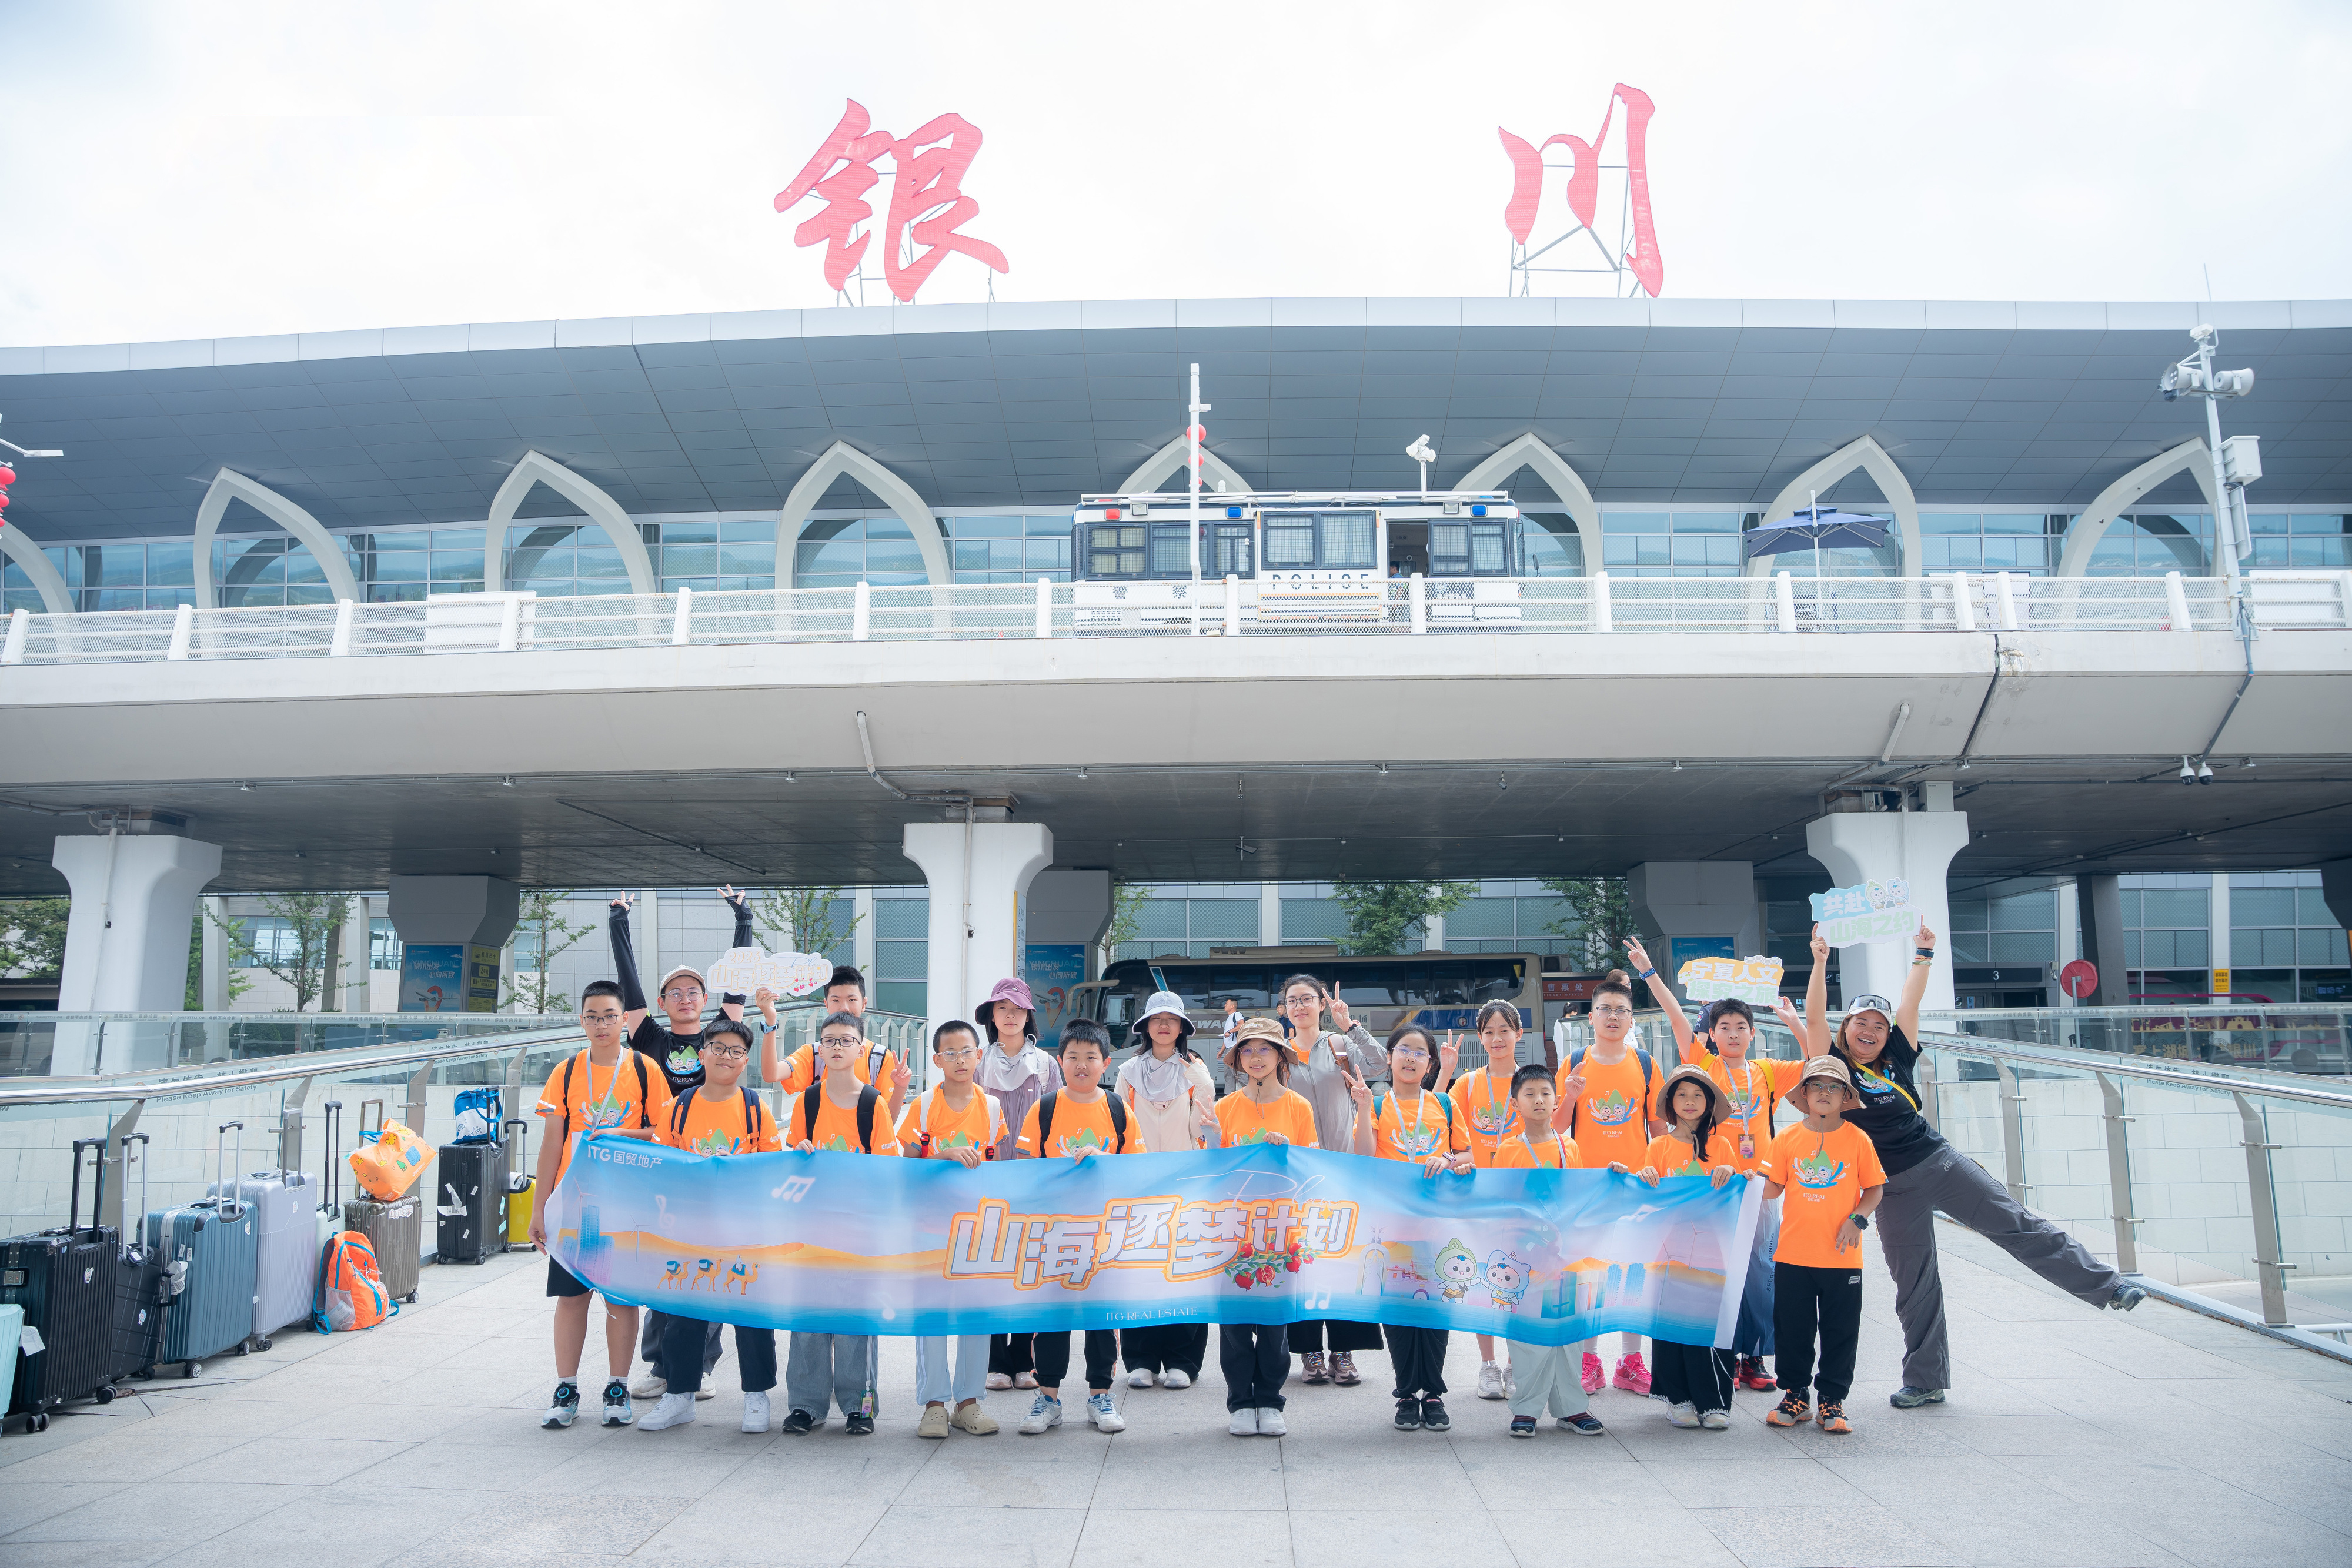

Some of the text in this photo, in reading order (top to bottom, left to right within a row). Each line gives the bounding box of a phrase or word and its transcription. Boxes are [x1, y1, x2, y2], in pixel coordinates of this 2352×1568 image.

[774, 82, 1663, 303] 银 川
[1273, 573, 1369, 590] POLICE
[1823, 891, 1866, 918] 共赴
[1830, 911, 1915, 944] 山海之约
[1031, 962, 1060, 971] 银川出发
[1048, 971, 1078, 979] 心向所致
[1691, 961, 1778, 984] 宁夏人文
[1993, 971, 1999, 981] 3
[711, 963, 828, 992] 山海逐梦计划
[1547, 983, 1583, 992] 售票处
[1688, 981, 1782, 1006] 探究之旅
[156, 1095, 181, 1103] Please
[588, 1145, 611, 1162] ITG
[613, 1150, 663, 1169] 国贸地产
[1176, 1169, 1340, 1207] Plan
[944, 1196, 1357, 1290] 山海逐梦计划
[1106, 1306, 1198, 1321] ITG REAL ESTATE
